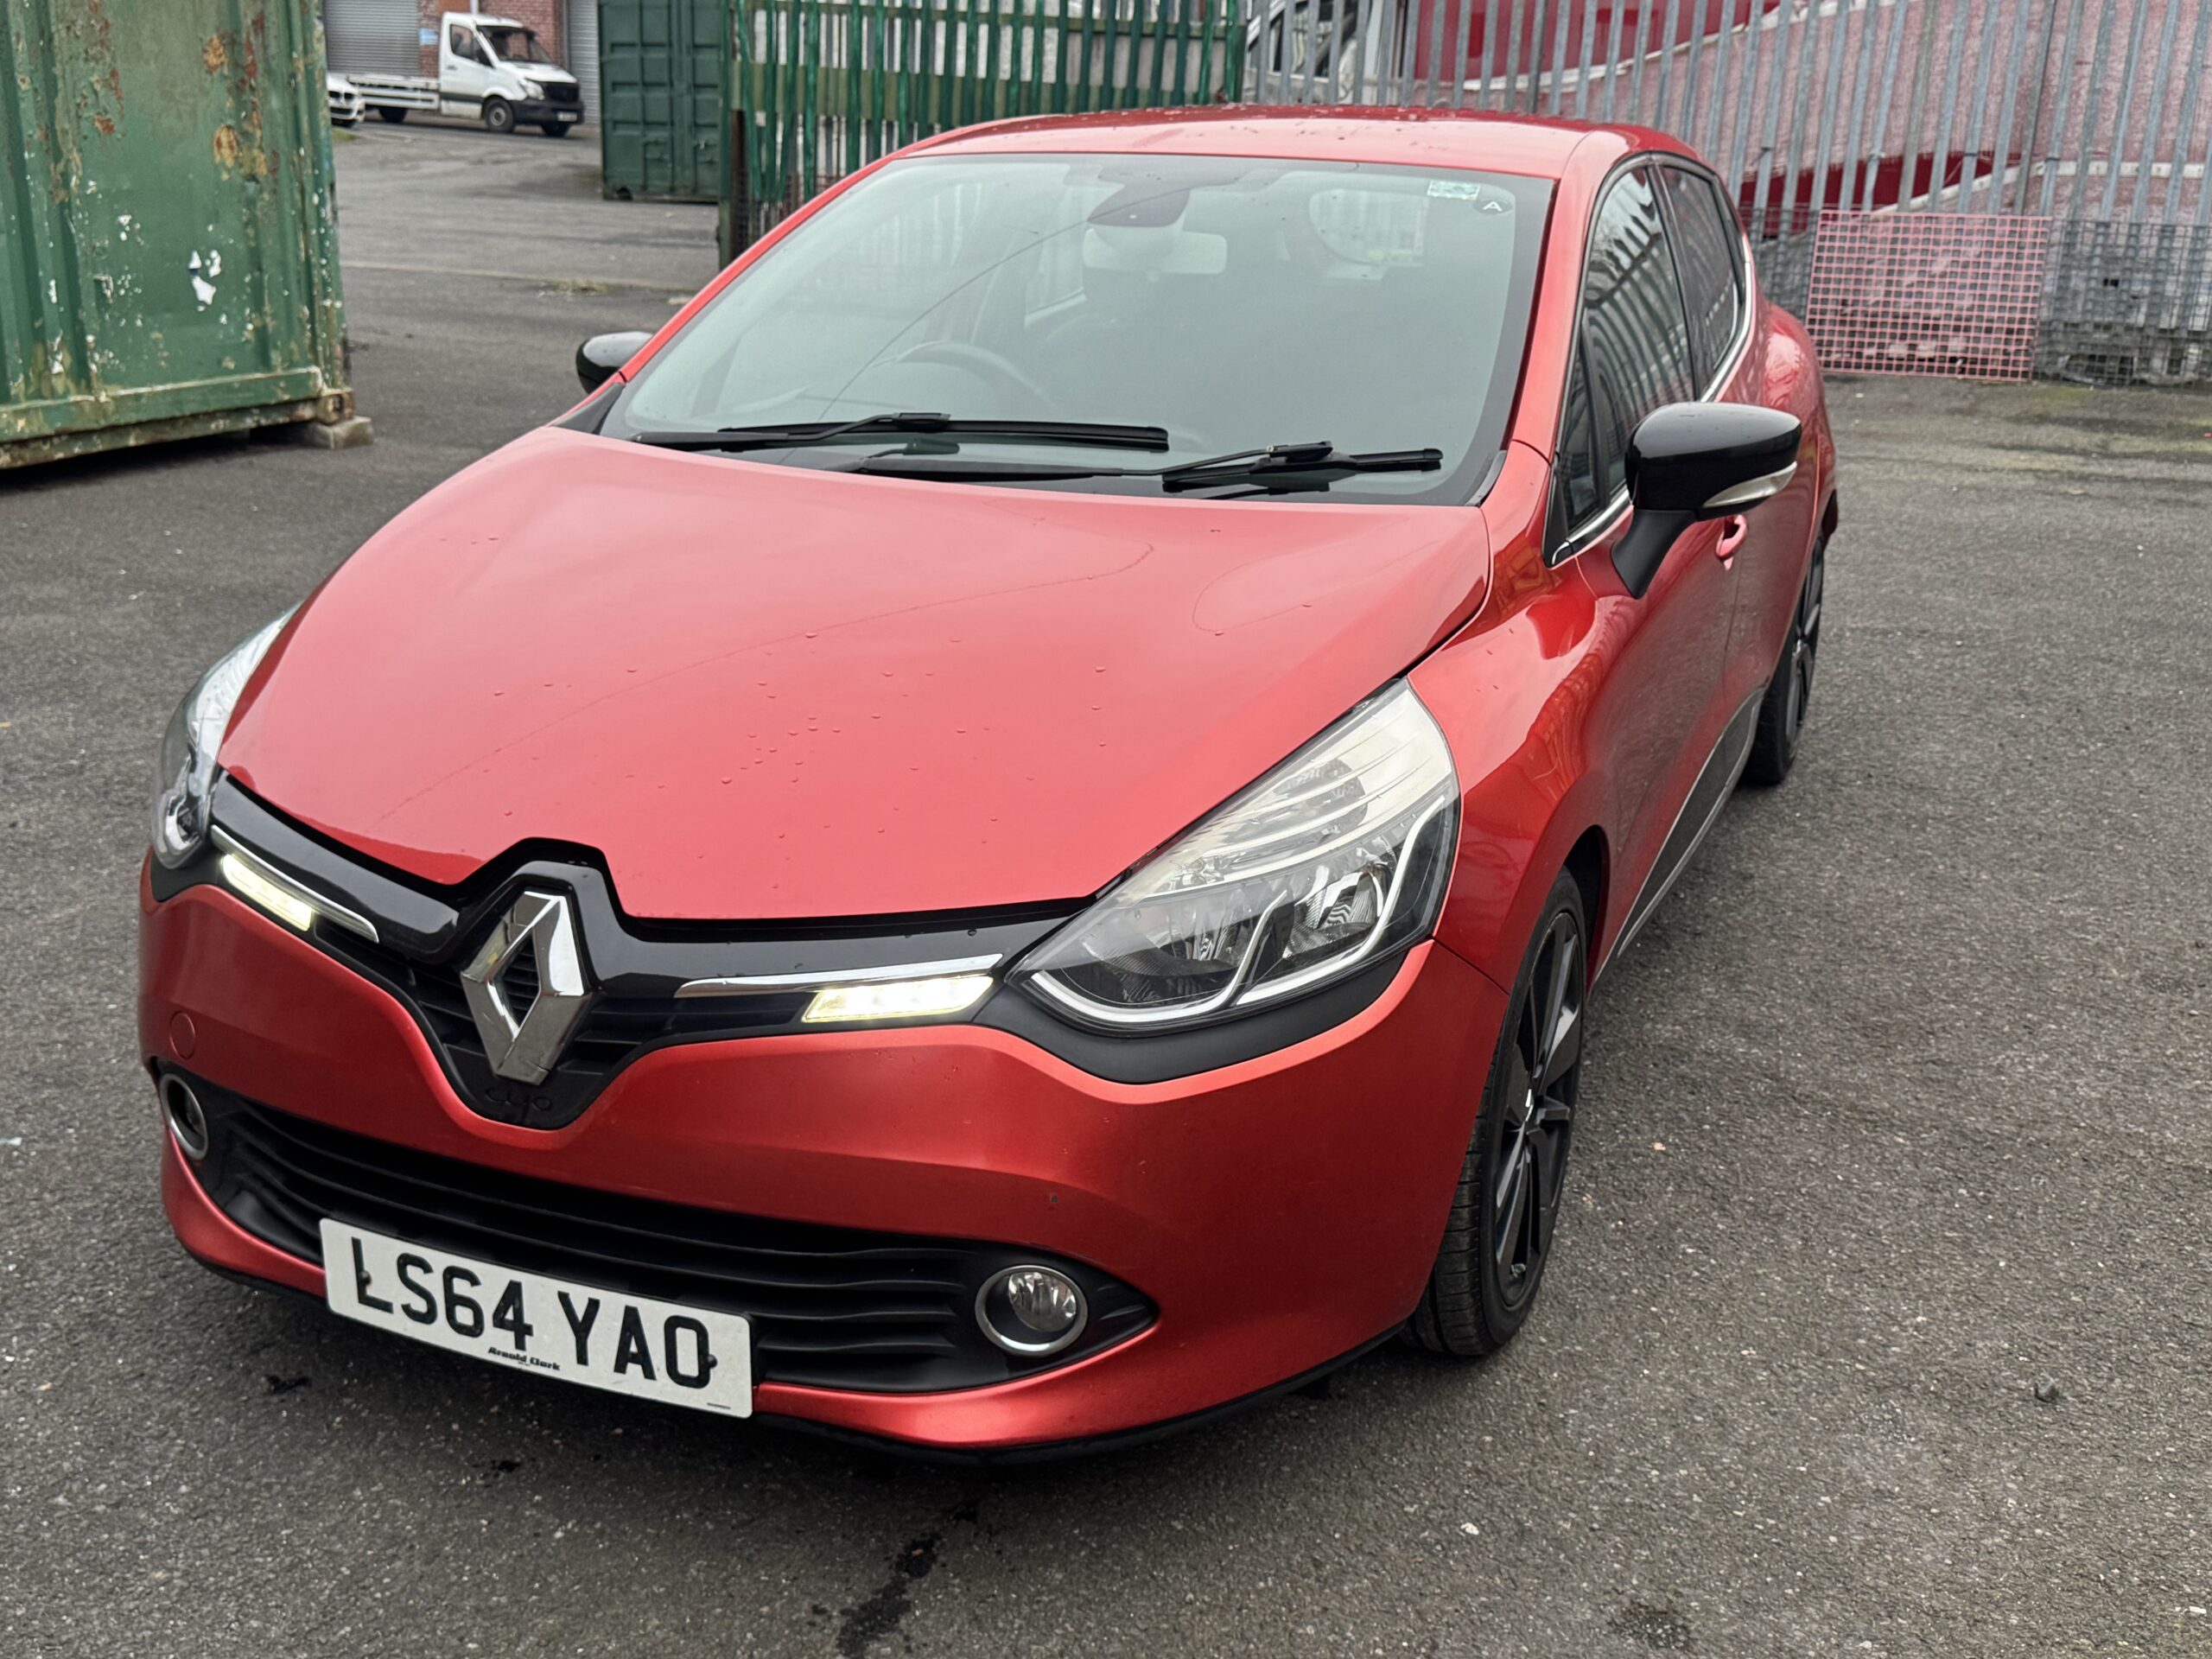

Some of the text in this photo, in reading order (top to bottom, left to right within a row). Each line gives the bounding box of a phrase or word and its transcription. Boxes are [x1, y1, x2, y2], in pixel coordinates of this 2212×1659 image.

[351, 1236, 711, 1389] LS64 YAO
[487, 1346, 560, 1371] Arnold Clark
